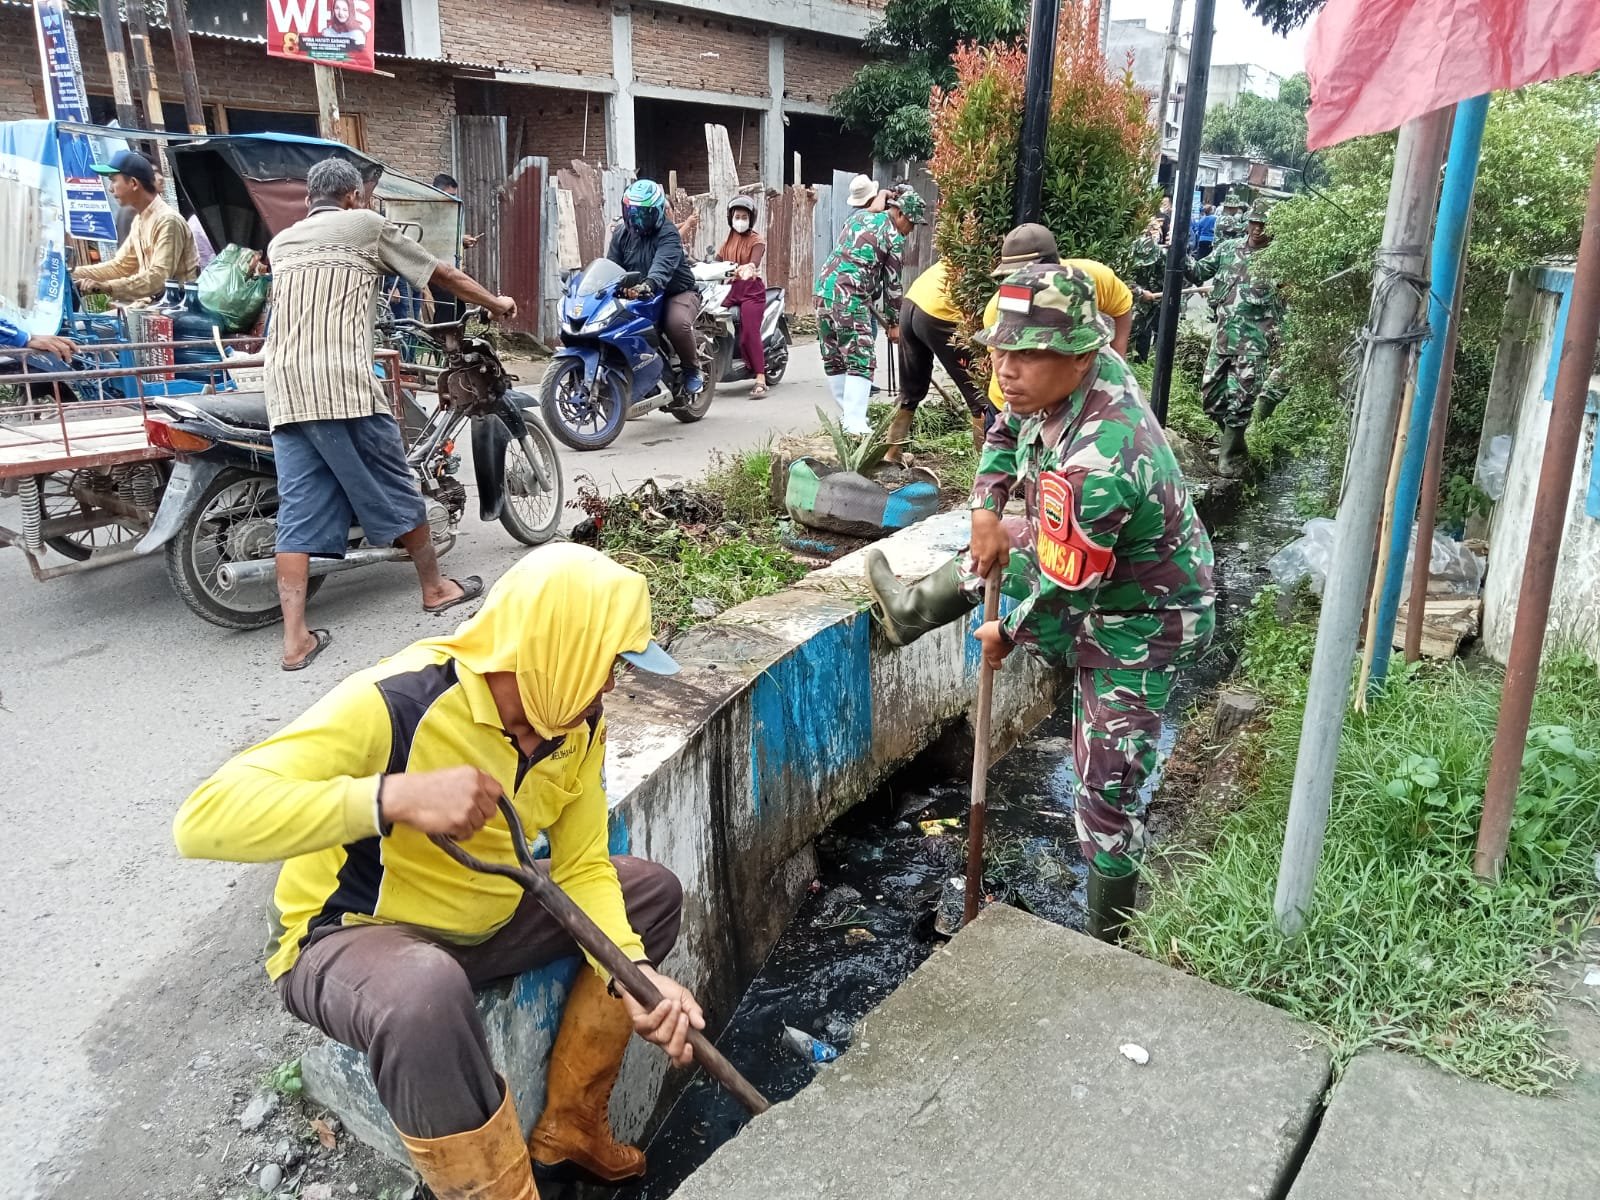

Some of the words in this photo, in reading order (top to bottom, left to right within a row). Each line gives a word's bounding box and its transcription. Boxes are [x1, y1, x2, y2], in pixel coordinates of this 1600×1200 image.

[283, 32, 299, 55] 8
[88, 220, 96, 232] 5
[49, 258, 60, 298] ISOPLUS
